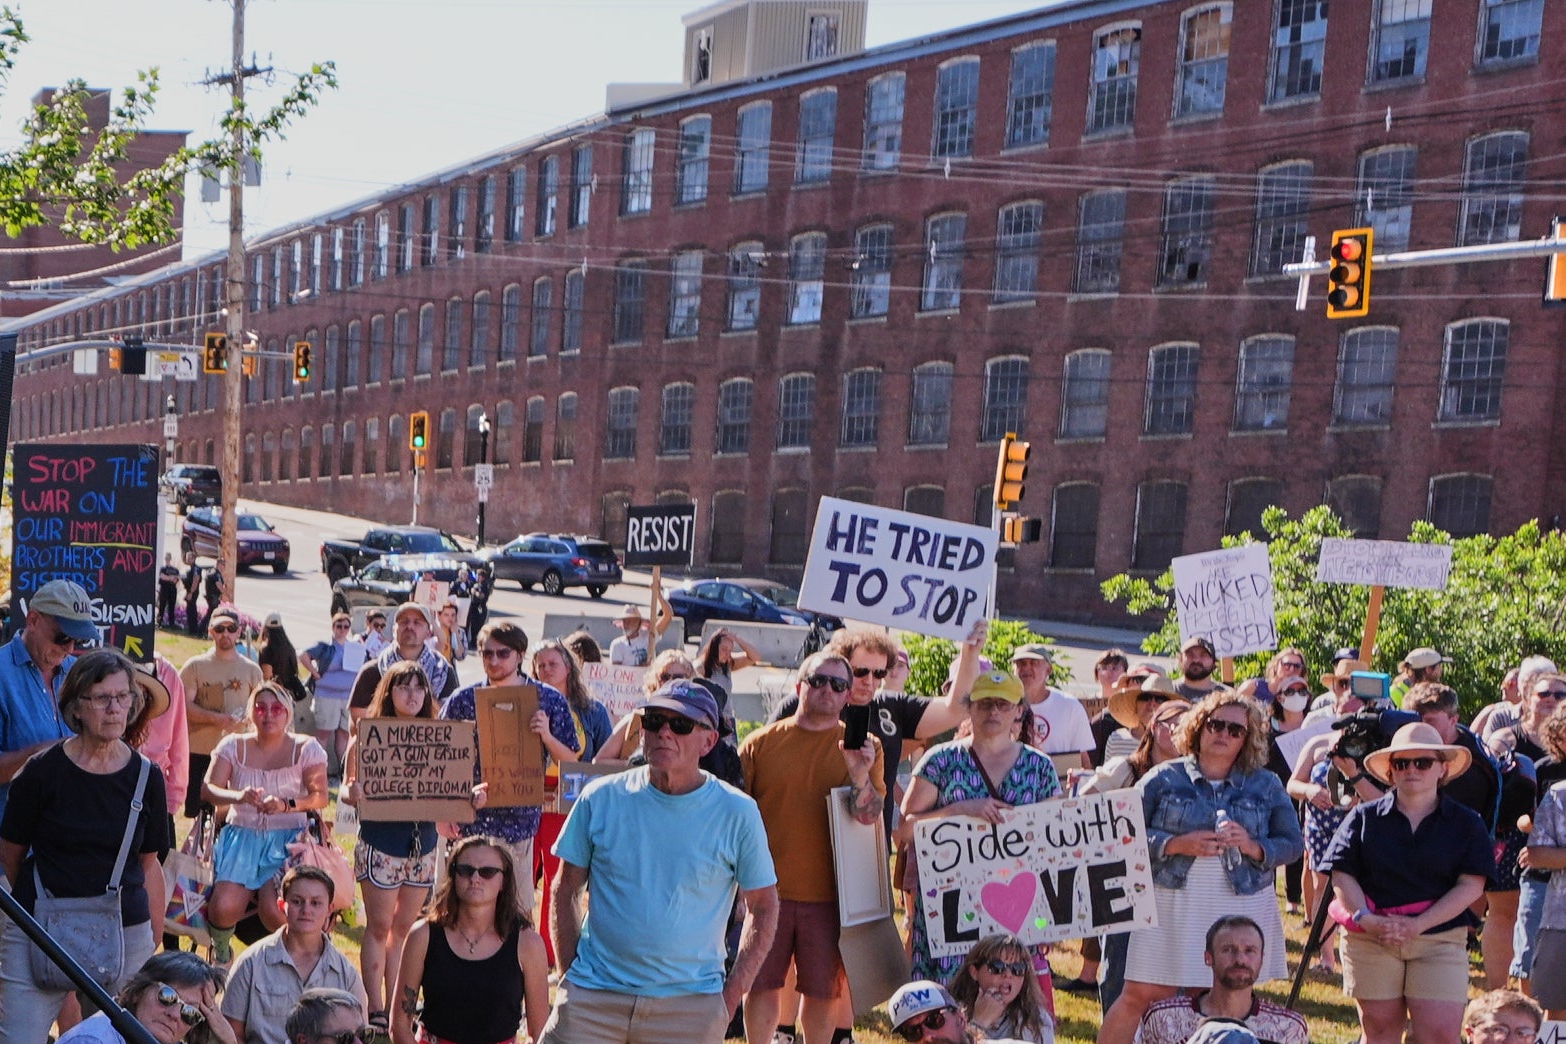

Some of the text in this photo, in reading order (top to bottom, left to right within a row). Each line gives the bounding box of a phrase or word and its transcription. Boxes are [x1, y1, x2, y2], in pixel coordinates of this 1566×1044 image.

[28, 455, 150, 487] STOP THE
[21, 489, 115, 514] WAR ON
[17, 517, 155, 546] OUR IMMIGRANT
[627, 515, 692, 552] RESIST
[825, 510, 985, 572] HE TRIED
[15, 545, 153, 573] BROTHERS AND
[829, 560, 978, 627] TO STOP
[1177, 574, 1269, 611] WICKED
[90, 598, 153, 626] SUSAN
[589, 665, 635, 682] NO ONE
[366, 725, 382, 746] A
[361, 748, 387, 764] GOT
[390, 748, 401, 761] A
[404, 747, 430, 761] GUN
[362, 765, 447, 779] THAN I GOT MY
[363, 780, 414, 795] COLLEGE
[417, 780, 471, 794] DIPLOMA!
[931, 799, 1136, 873] Side with
